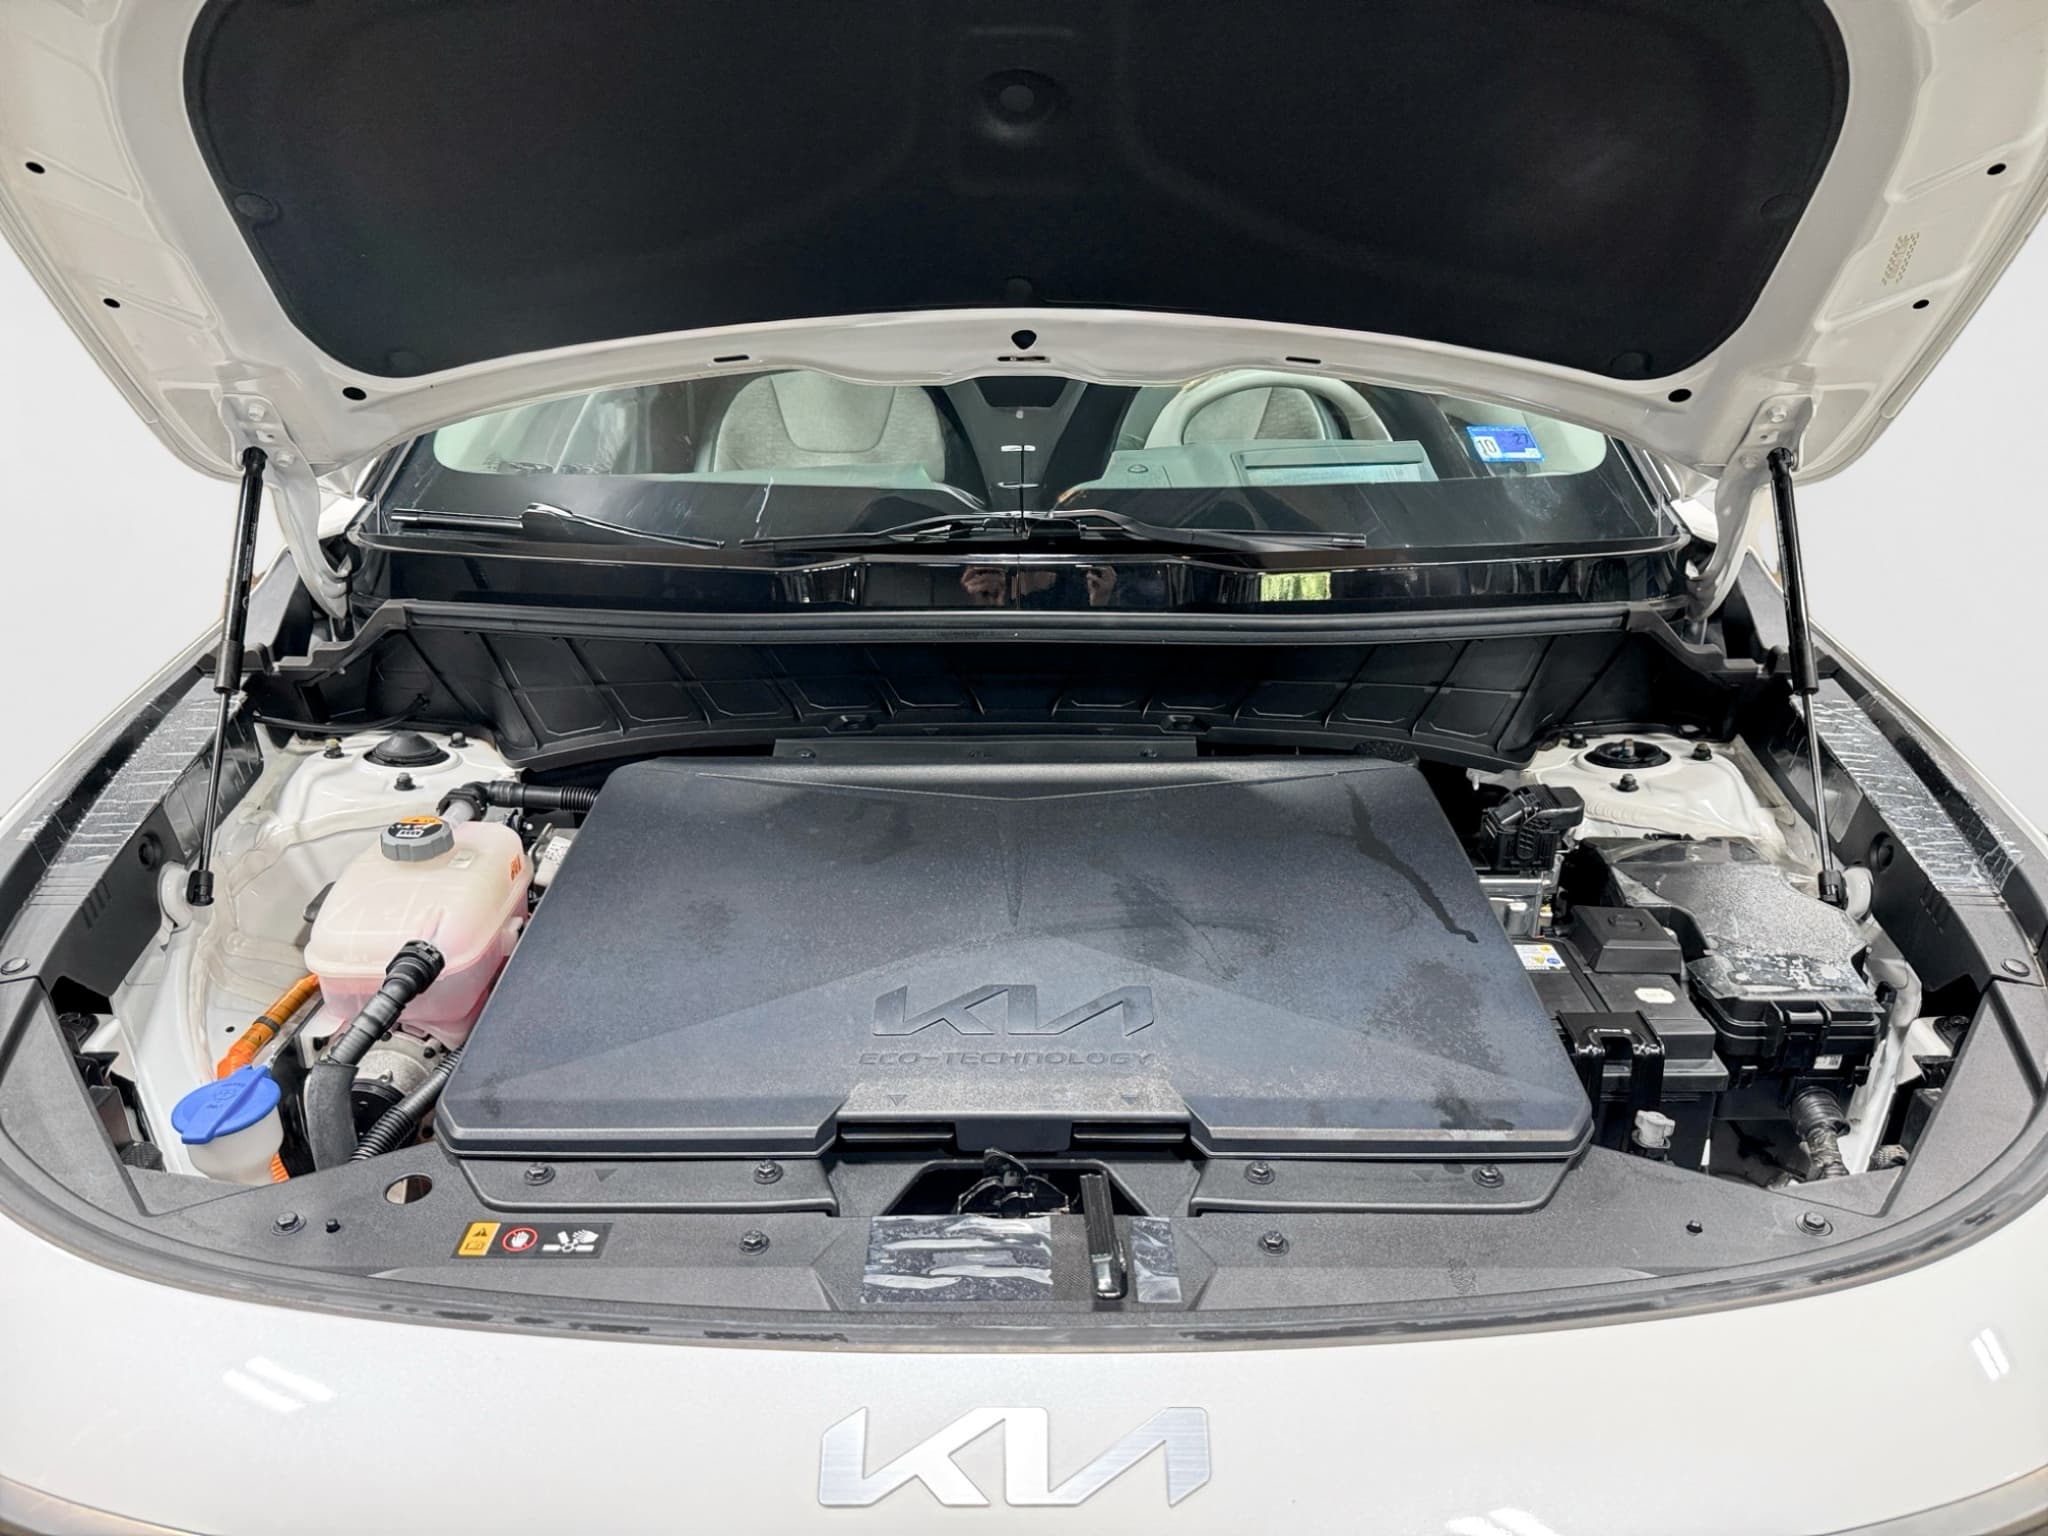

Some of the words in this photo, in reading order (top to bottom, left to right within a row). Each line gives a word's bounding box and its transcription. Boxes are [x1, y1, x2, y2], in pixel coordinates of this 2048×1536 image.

[1477, 439, 1497, 456] 10
[872, 984, 1154, 1036] KIA
[858, 1052, 1155, 1065] ECO-TECHNOLOGY
[818, 1407, 1212, 1508] KIA
